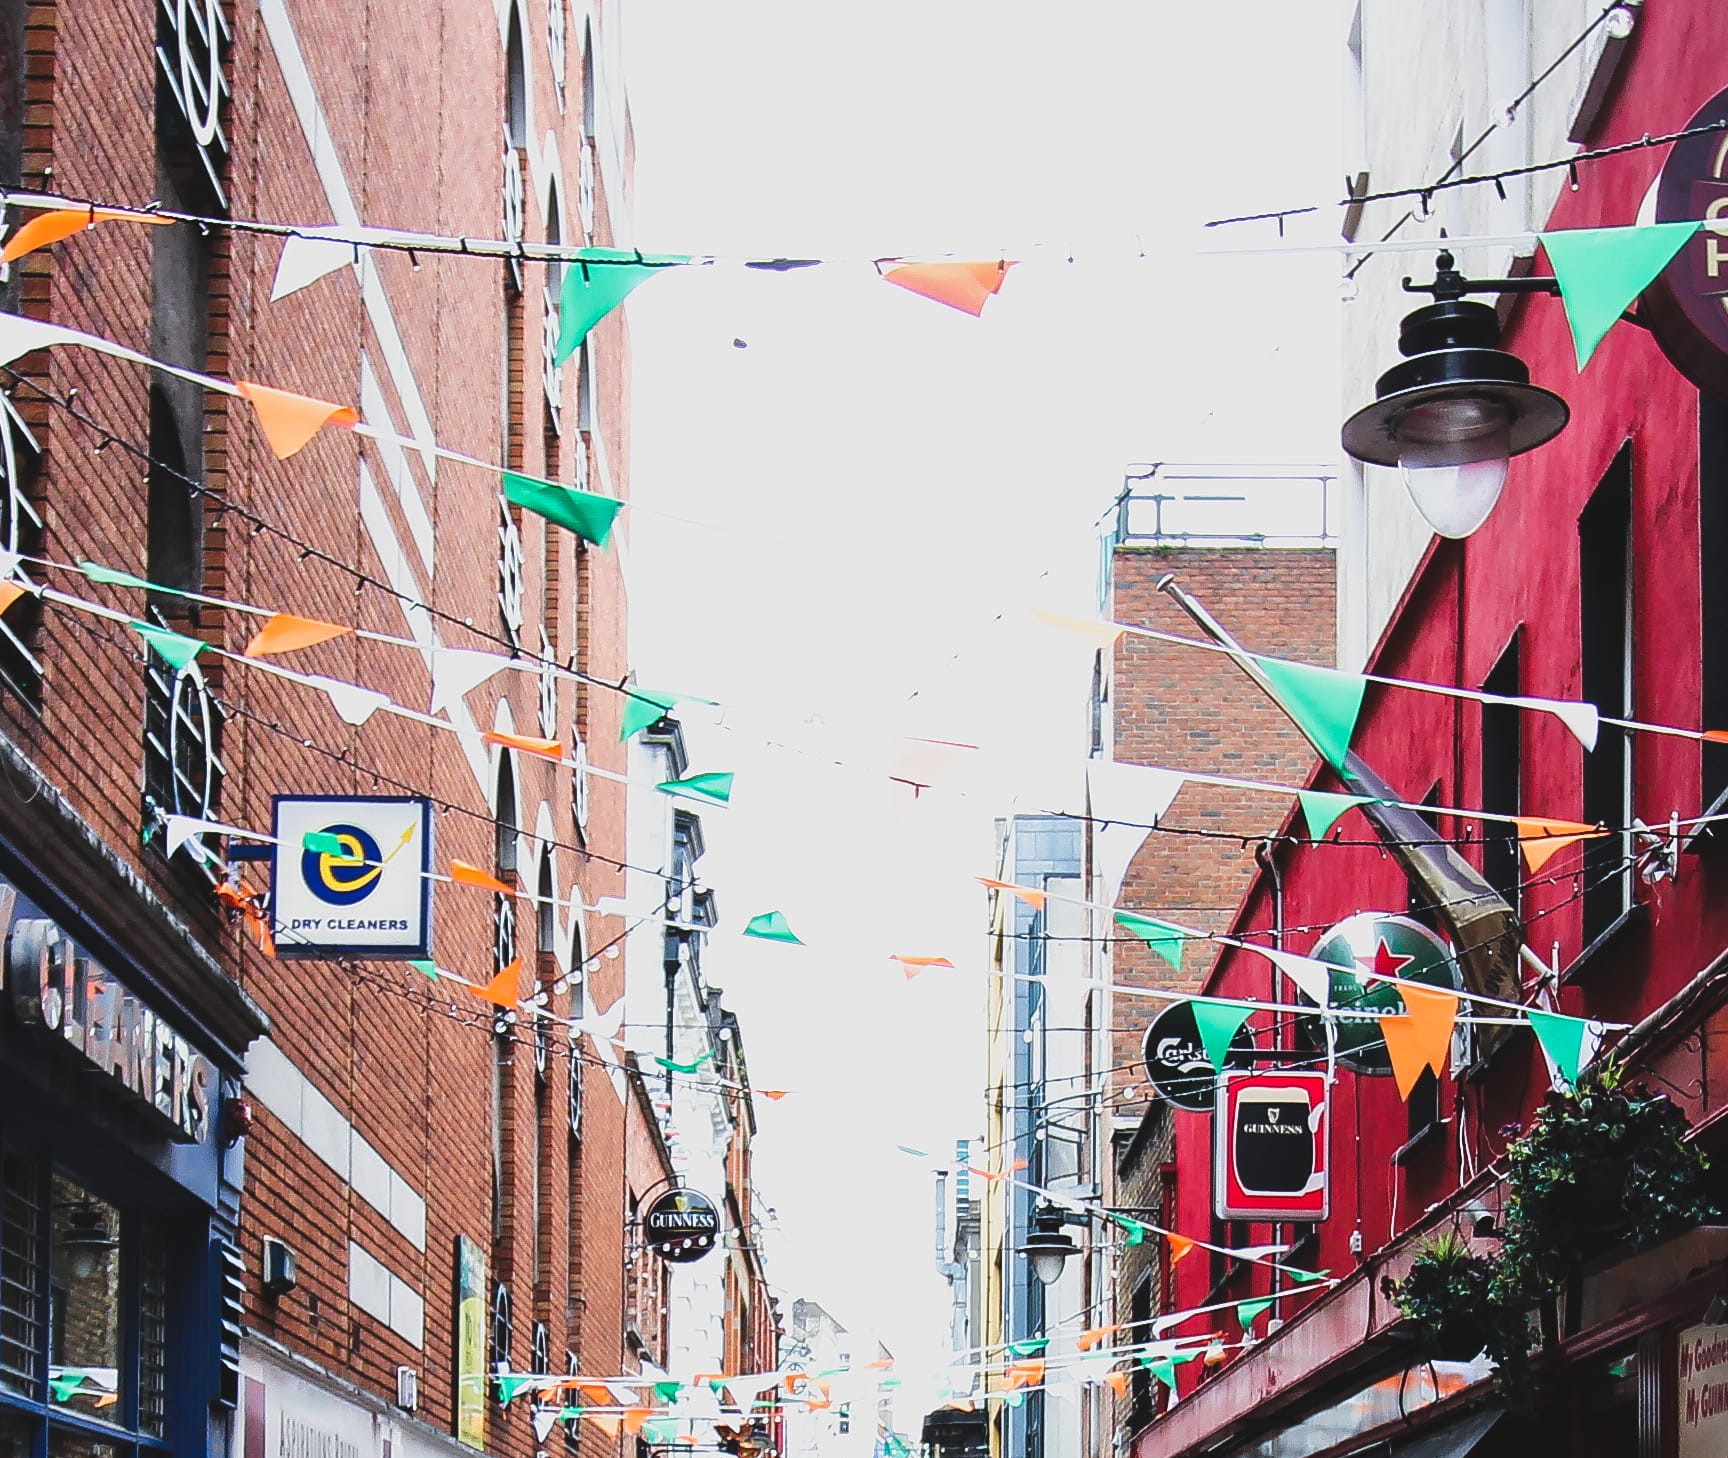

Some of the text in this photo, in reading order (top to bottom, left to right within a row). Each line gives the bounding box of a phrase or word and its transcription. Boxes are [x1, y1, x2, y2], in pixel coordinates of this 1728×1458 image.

[291, 919, 409, 931] DRY CLEANERS
[11, 918, 212, 1145] CLEANERS
[1242, 1123, 1304, 1136] GUINNESS
[650, 1212, 715, 1228] GUINNESS
[1679, 1341, 1694, 1382] My
[1685, 1387, 1700, 1428] My
